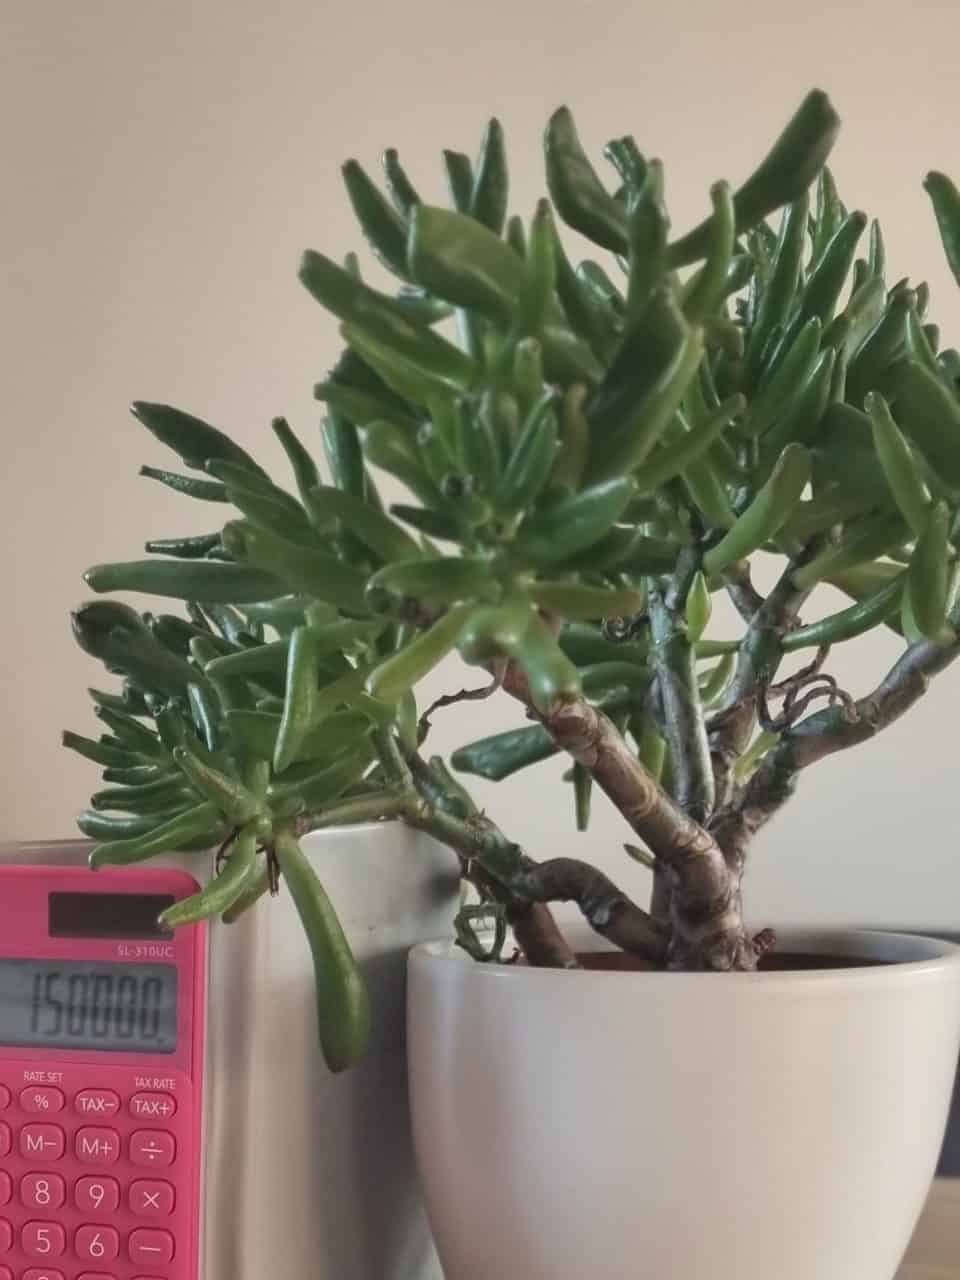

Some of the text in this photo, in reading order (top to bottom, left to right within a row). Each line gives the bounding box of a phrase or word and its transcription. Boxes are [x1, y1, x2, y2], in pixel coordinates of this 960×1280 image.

[118, 943, 175, 958] SL-310UC
[23, 1070, 64, 1083] RATE SET
[134, 1076, 176, 1090] TAX RATE
[134, 1099, 170, 1116] TAX+
[82, 1139, 113, 1156] M+
[35, 1180, 51, 1205] 8
[89, 1184, 105, 1209] 9
[36, 1229, 50, 1254] 5
[89, 1233, 105, 1258] 6
